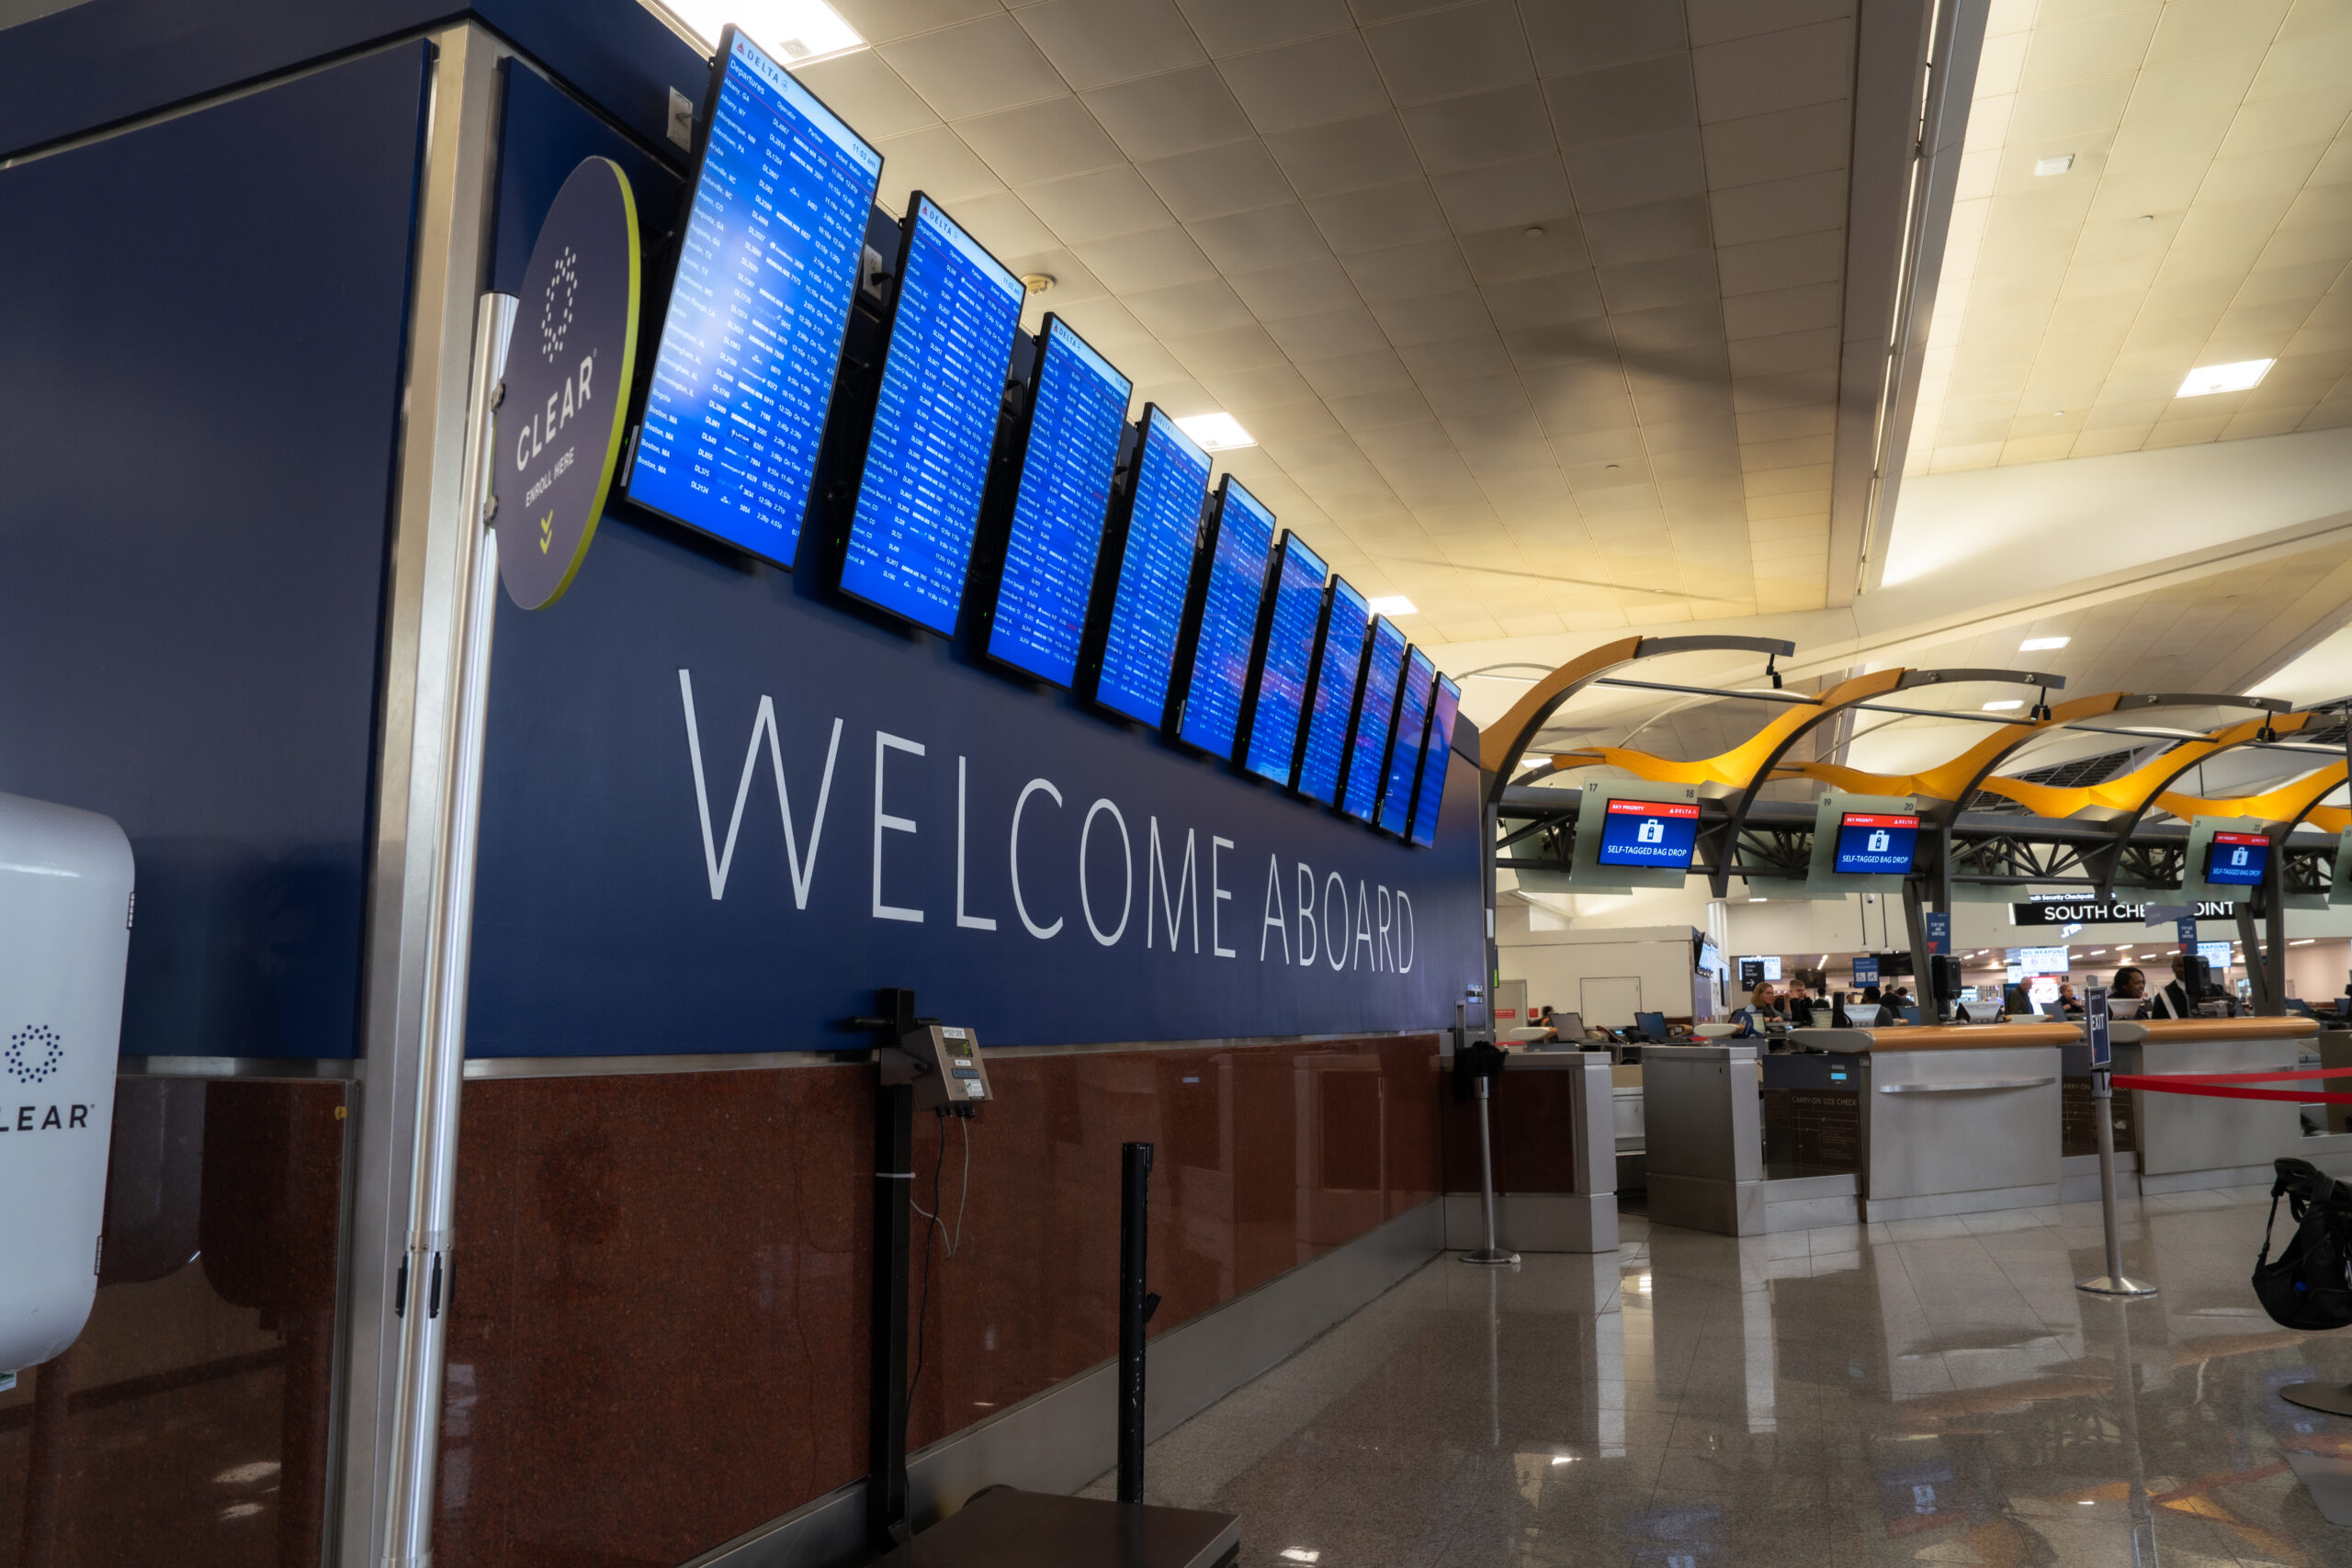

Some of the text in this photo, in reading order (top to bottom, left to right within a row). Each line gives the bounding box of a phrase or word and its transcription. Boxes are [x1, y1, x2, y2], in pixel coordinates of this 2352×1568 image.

[747, 49, 779, 84] DELTA
[729, 59, 765, 96] Departures
[776, 100, 796, 122] Operator
[808, 127, 823, 144] Partner
[741, 91, 750, 103] GA
[738, 107, 745, 118] NY
[728, 174, 736, 185] NC
[724, 189, 732, 200] NC
[715, 201, 723, 212] CO
[929, 209, 952, 236] DELTA
[917, 220, 942, 247] Departures
[819, 294, 837, 312] Boarding
[1058, 327, 1076, 347] DELTA
[651, 388, 671, 404] Bogota
[516, 355, 593, 471] CLEAR
[648, 404, 669, 421] Boston,
[668, 414, 678, 425] MA
[644, 421, 664, 437] Boston,
[664, 431, 674, 442] MA
[640, 437, 661, 454] Boston,
[661, 447, 670, 457] MA
[637, 455, 657, 470] Boston,
[657, 465, 666, 475] MA
[526, 446, 574, 507] ENROLL HERE
[1589, 783, 1694, 798] 17 18
[1824, 798, 1914, 811] 19 20
[679, 669, 1235, 958] WELCOME
[1261, 853, 1415, 975] ABOARD
[1608, 845, 1687, 857] SELF-TAGGED BAG DROP
[1842, 854, 1879, 863] SELF-TAGGED
[1893, 856, 1908, 864] DROP
[2212, 867, 2240, 875] SELF-TAGGED
[2044, 905, 2108, 920] SOUTH
[2091, 1013, 2105, 1031] EXIT
